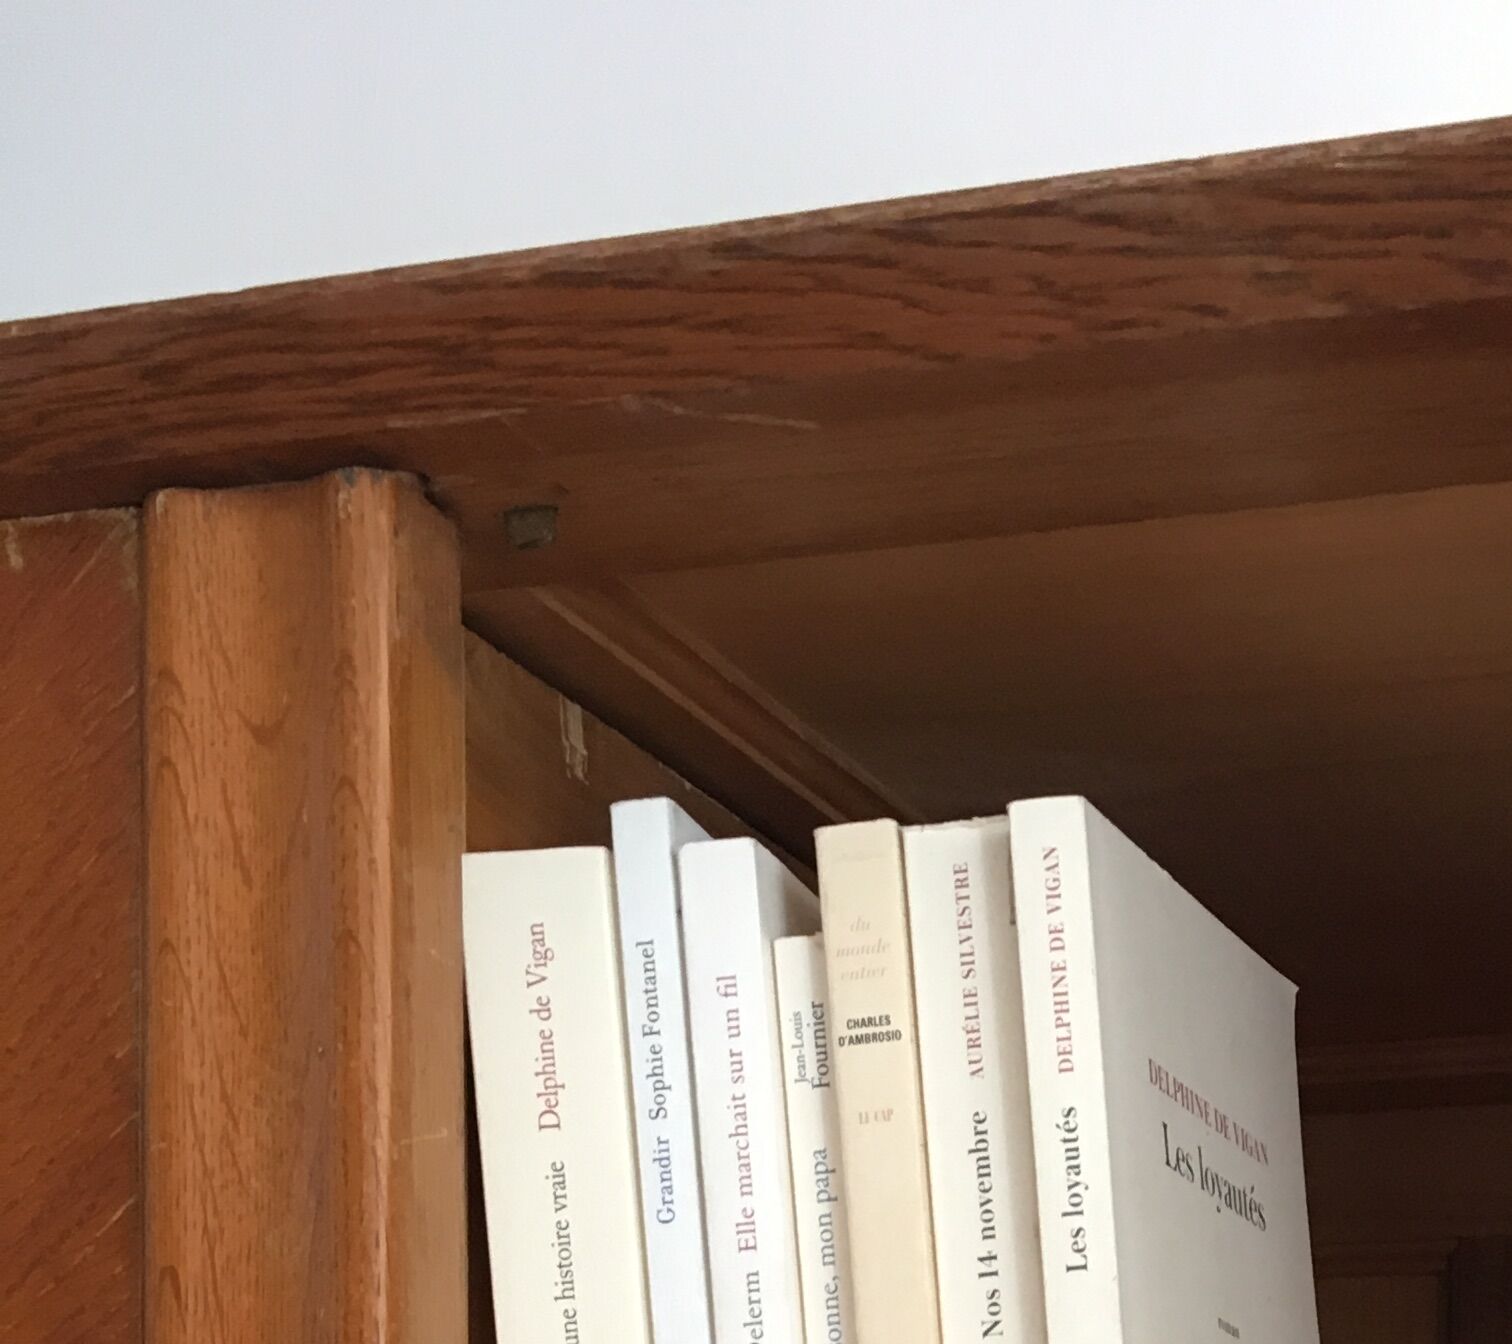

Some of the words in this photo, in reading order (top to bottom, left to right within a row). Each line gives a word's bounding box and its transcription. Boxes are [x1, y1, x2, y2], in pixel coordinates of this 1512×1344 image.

[1042, 847, 1062, 915] VIGAN
[953, 862, 976, 980] SILVESTRE
[1048, 922, 1066, 953] DE
[525, 922, 555, 989] Vigan
[636, 939, 662, 1038] Fontanel
[715, 973, 739, 999] fil
[529, 995, 553, 1021] de
[724, 1008, 742, 1040] un
[838, 1030, 902, 1048] D'AMBROSIO
[846, 1014, 891, 1030] CHARLES
[962, 986, 984, 1079] AURÉLIE
[1051, 960, 1074, 1074] DELPHINE
[535, 1028, 565, 1132] Delphine
[728, 1048, 746, 1085] sur
[789, 1011, 810, 1084] Jean-Louis
[807, 1001, 831, 1091] Fournier
[646, 1044, 672, 1120] Sophie
[1148, 1058, 1213, 1128] DELPHINE
[1213, 1107, 1231, 1141] DE
[1232, 1121, 1270, 1167] VIGAN
[652, 1135, 677, 1224] Grandir
[727, 1094, 754, 1197] marchait
[812, 1148, 839, 1204] papa
[968, 1111, 997, 1241] novembre
[1055, 1105, 1090, 1218] loyautés
[1162, 1121, 1196, 1184] Les
[1197, 1145, 1267, 1232] loyautés
[545, 1160, 568, 1214] vraie
[551, 1219, 577, 1302] histoire
[736, 1207, 758, 1254] Elle
[818, 1212, 836, 1267] mon
[977, 1250, 999, 1279] 14
[1066, 1226, 1088, 1273] Les
[980, 1288, 1004, 1339] Nos
